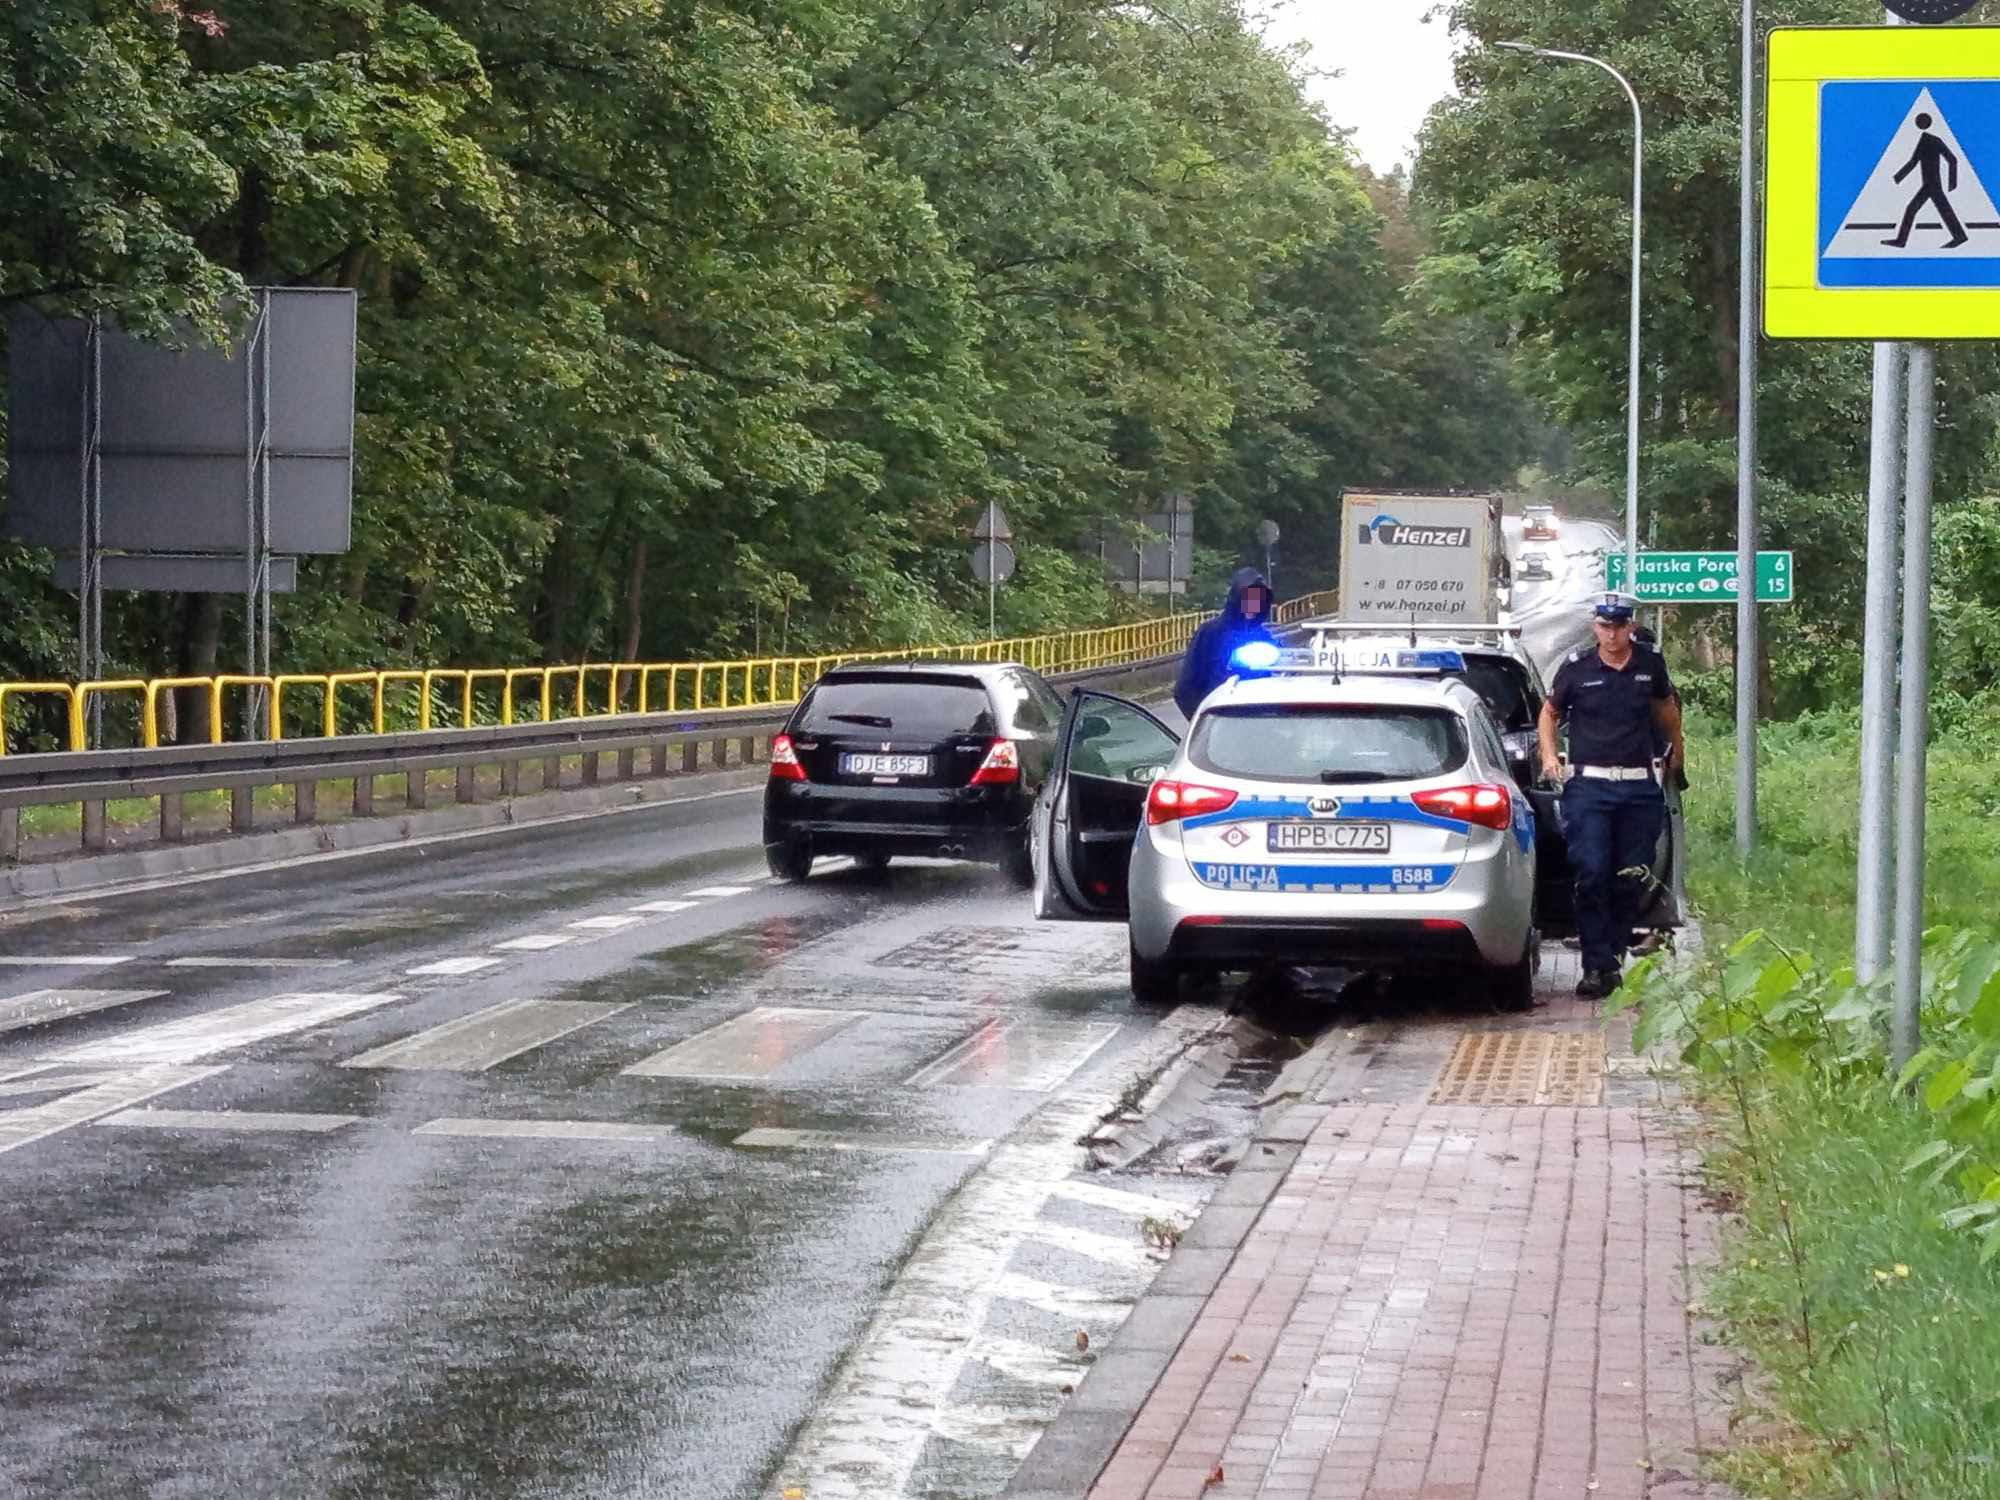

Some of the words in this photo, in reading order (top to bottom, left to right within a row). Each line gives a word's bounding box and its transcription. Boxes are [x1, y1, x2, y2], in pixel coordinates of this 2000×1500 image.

[1392, 527, 1466, 546] Henzel
[1698, 557, 1739, 576] Porę
[1775, 556, 1785, 572] 6
[1767, 577, 1785, 592] 15
[1319, 651, 1392, 668] POLICJA
[855, 756, 885, 772] DJE
[1282, 826, 1327, 846] HPB
[1206, 865, 1279, 884] POLICJA
